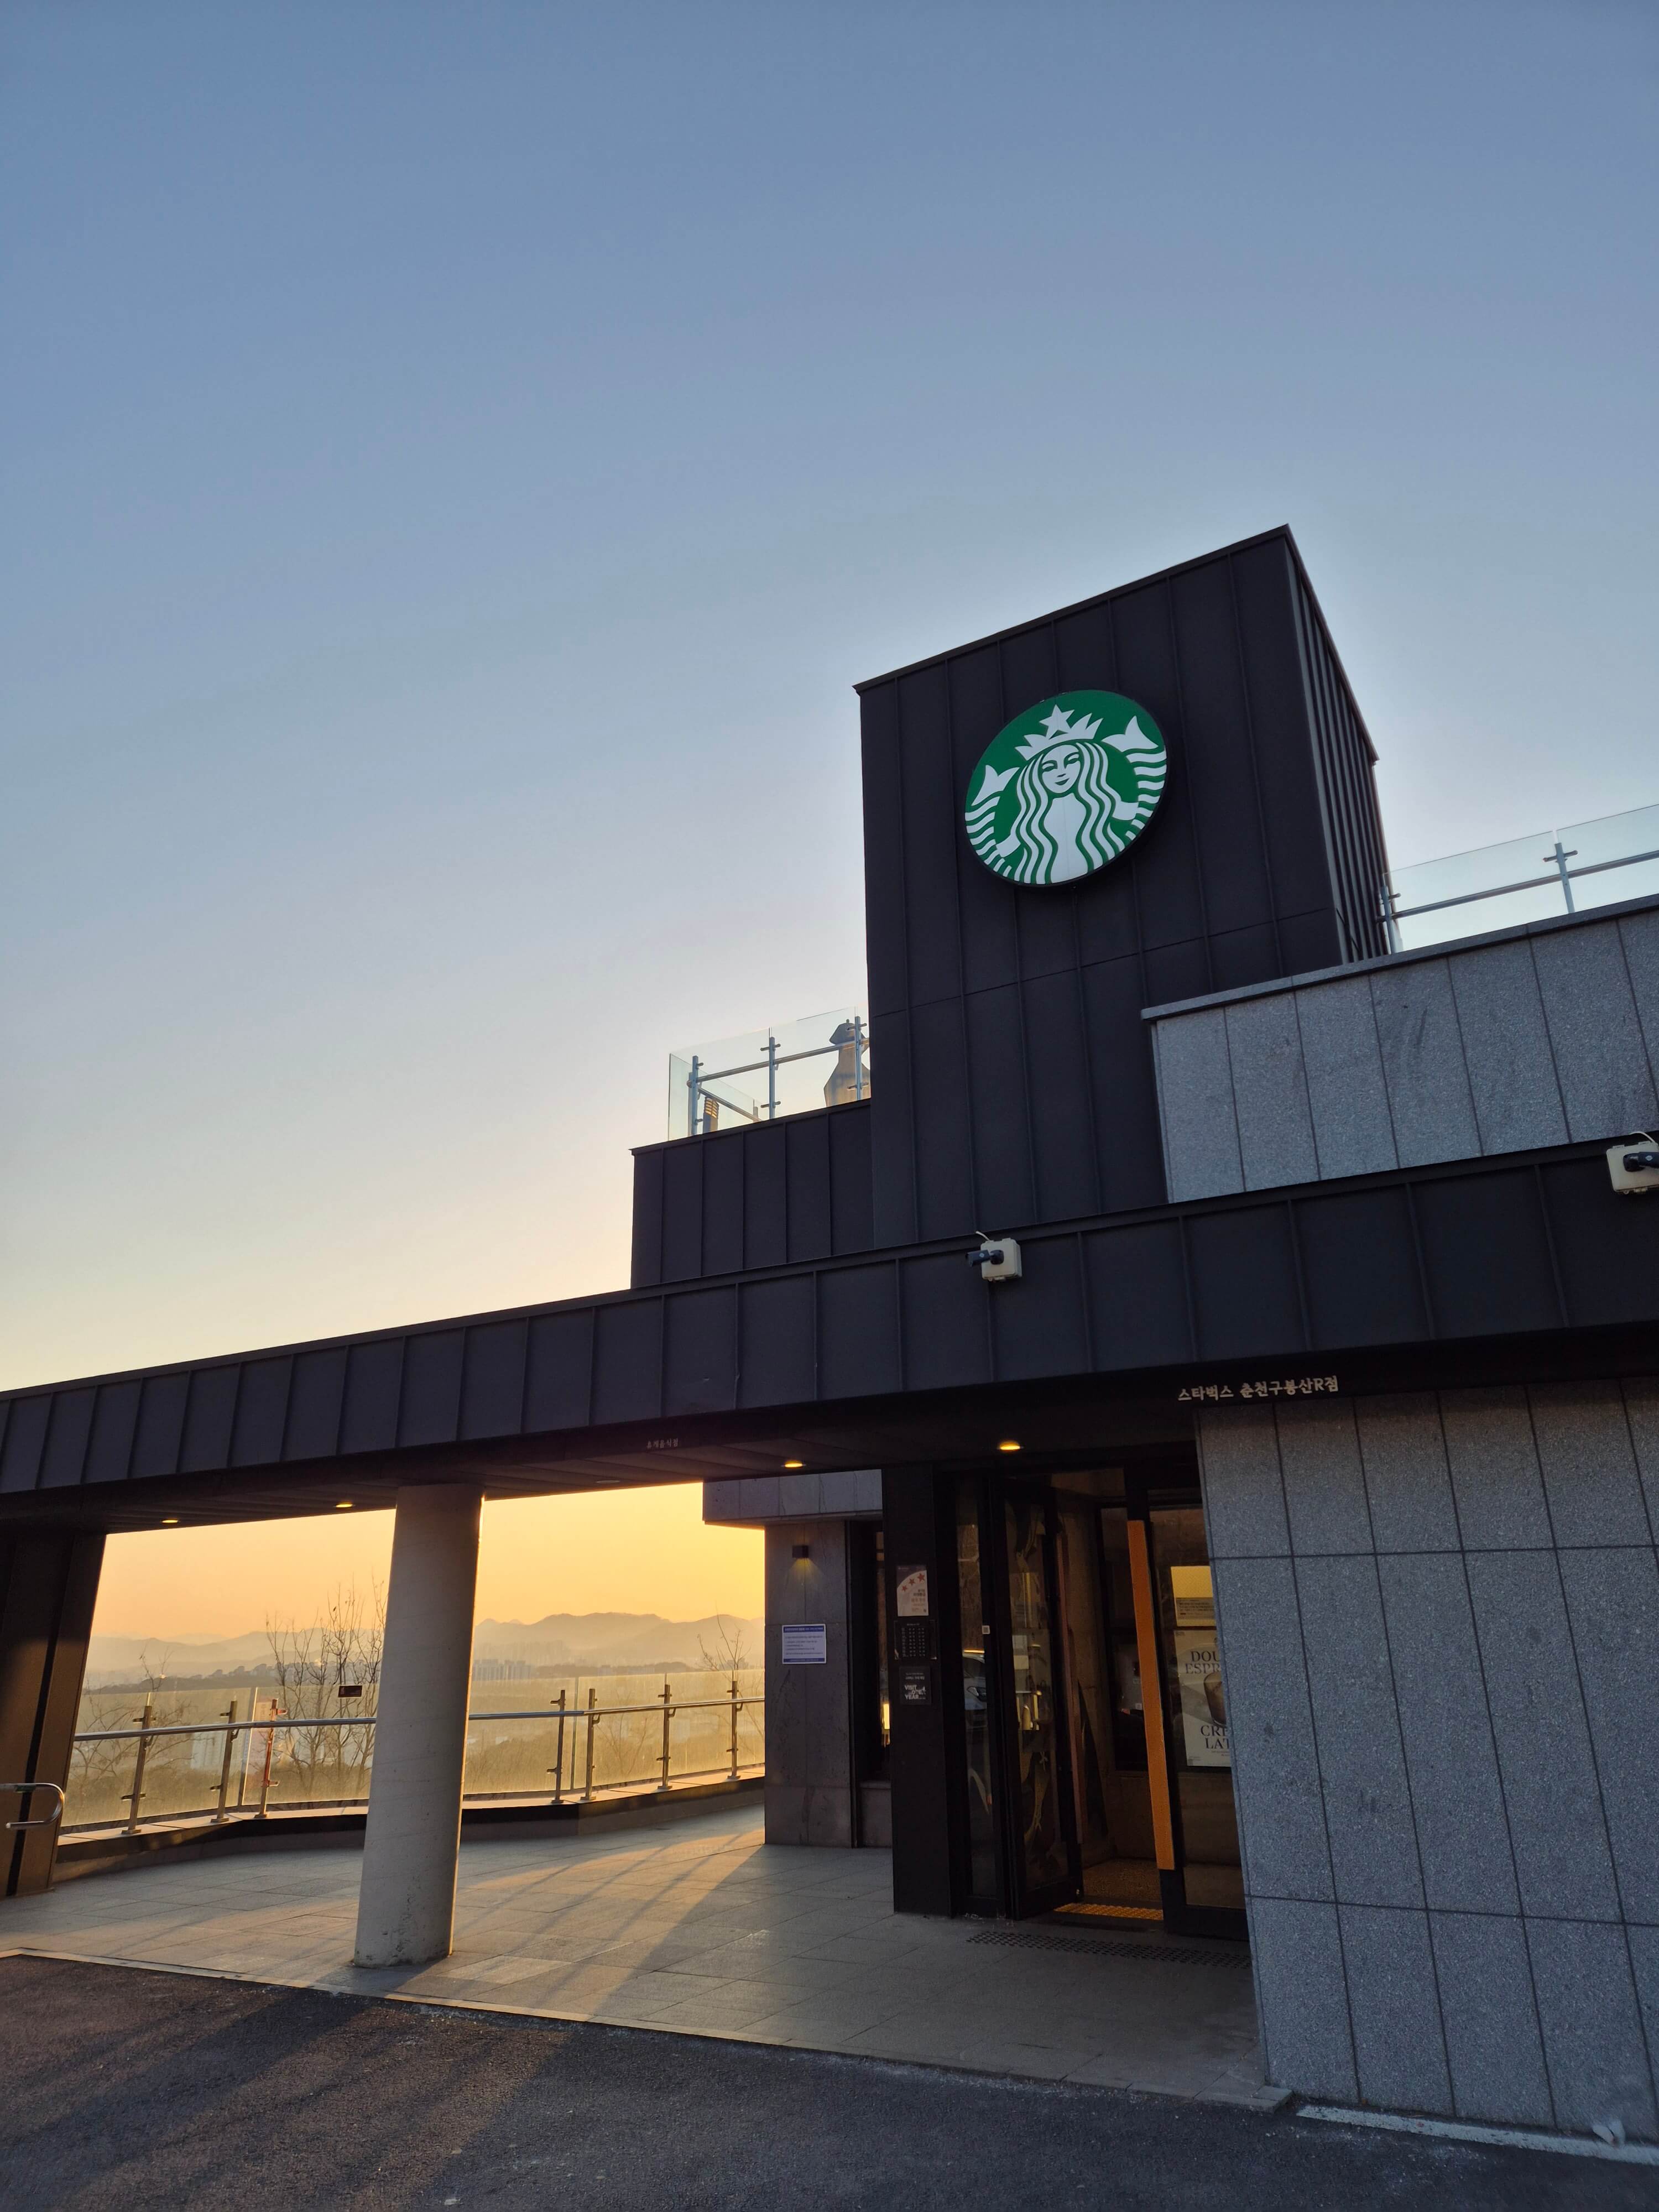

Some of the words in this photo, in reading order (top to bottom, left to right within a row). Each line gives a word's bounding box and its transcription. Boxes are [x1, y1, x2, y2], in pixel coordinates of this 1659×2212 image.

[1177, 1384, 1234, 1401] 스타벅스
[1239, 1375, 1339, 1398] 춘천구봉산R점
[646, 1438, 679, 1449] 휴게음식점
